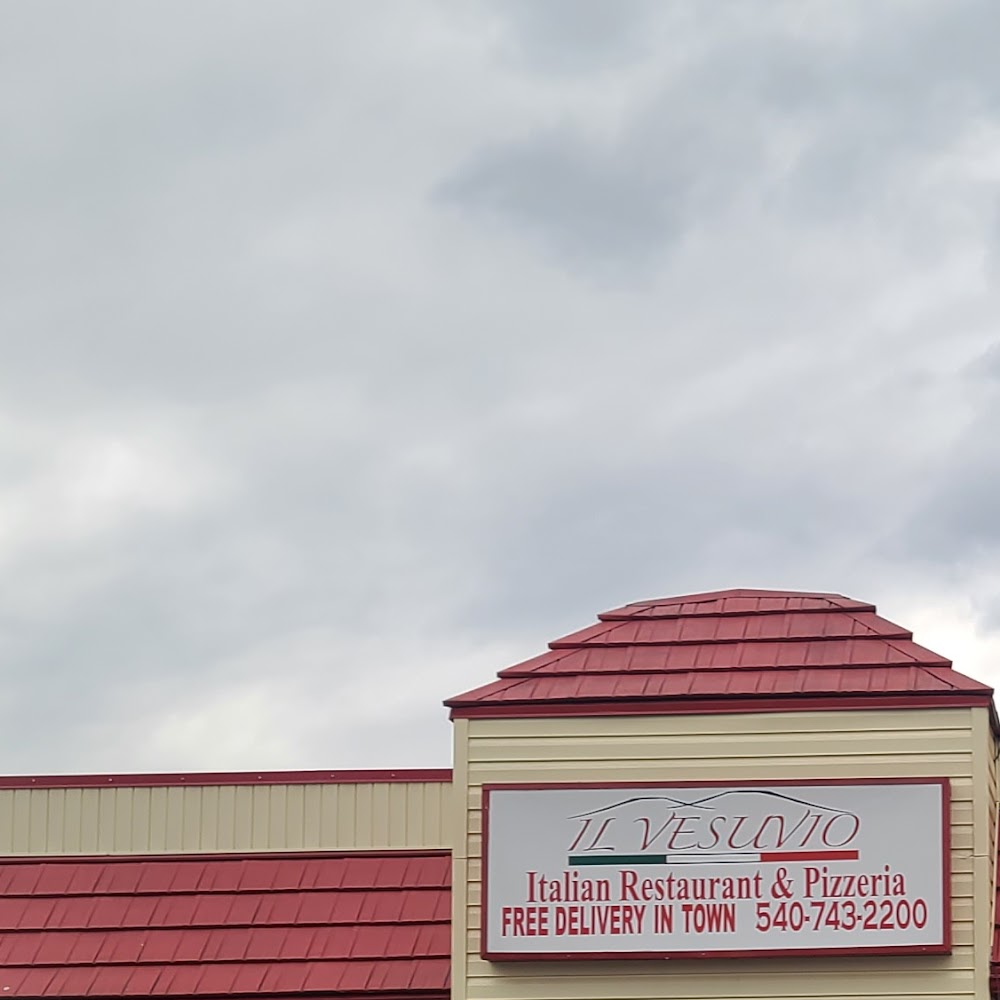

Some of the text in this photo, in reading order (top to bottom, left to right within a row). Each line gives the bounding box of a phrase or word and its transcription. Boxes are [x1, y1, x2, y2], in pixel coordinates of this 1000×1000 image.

[568, 810, 860, 851] IL VESUVIO
[527, 864, 906, 902] Italian Restaurant & Pizzeria
[502, 899, 927, 936] FREE DELIVERY IN TOWN 540-743-2200
